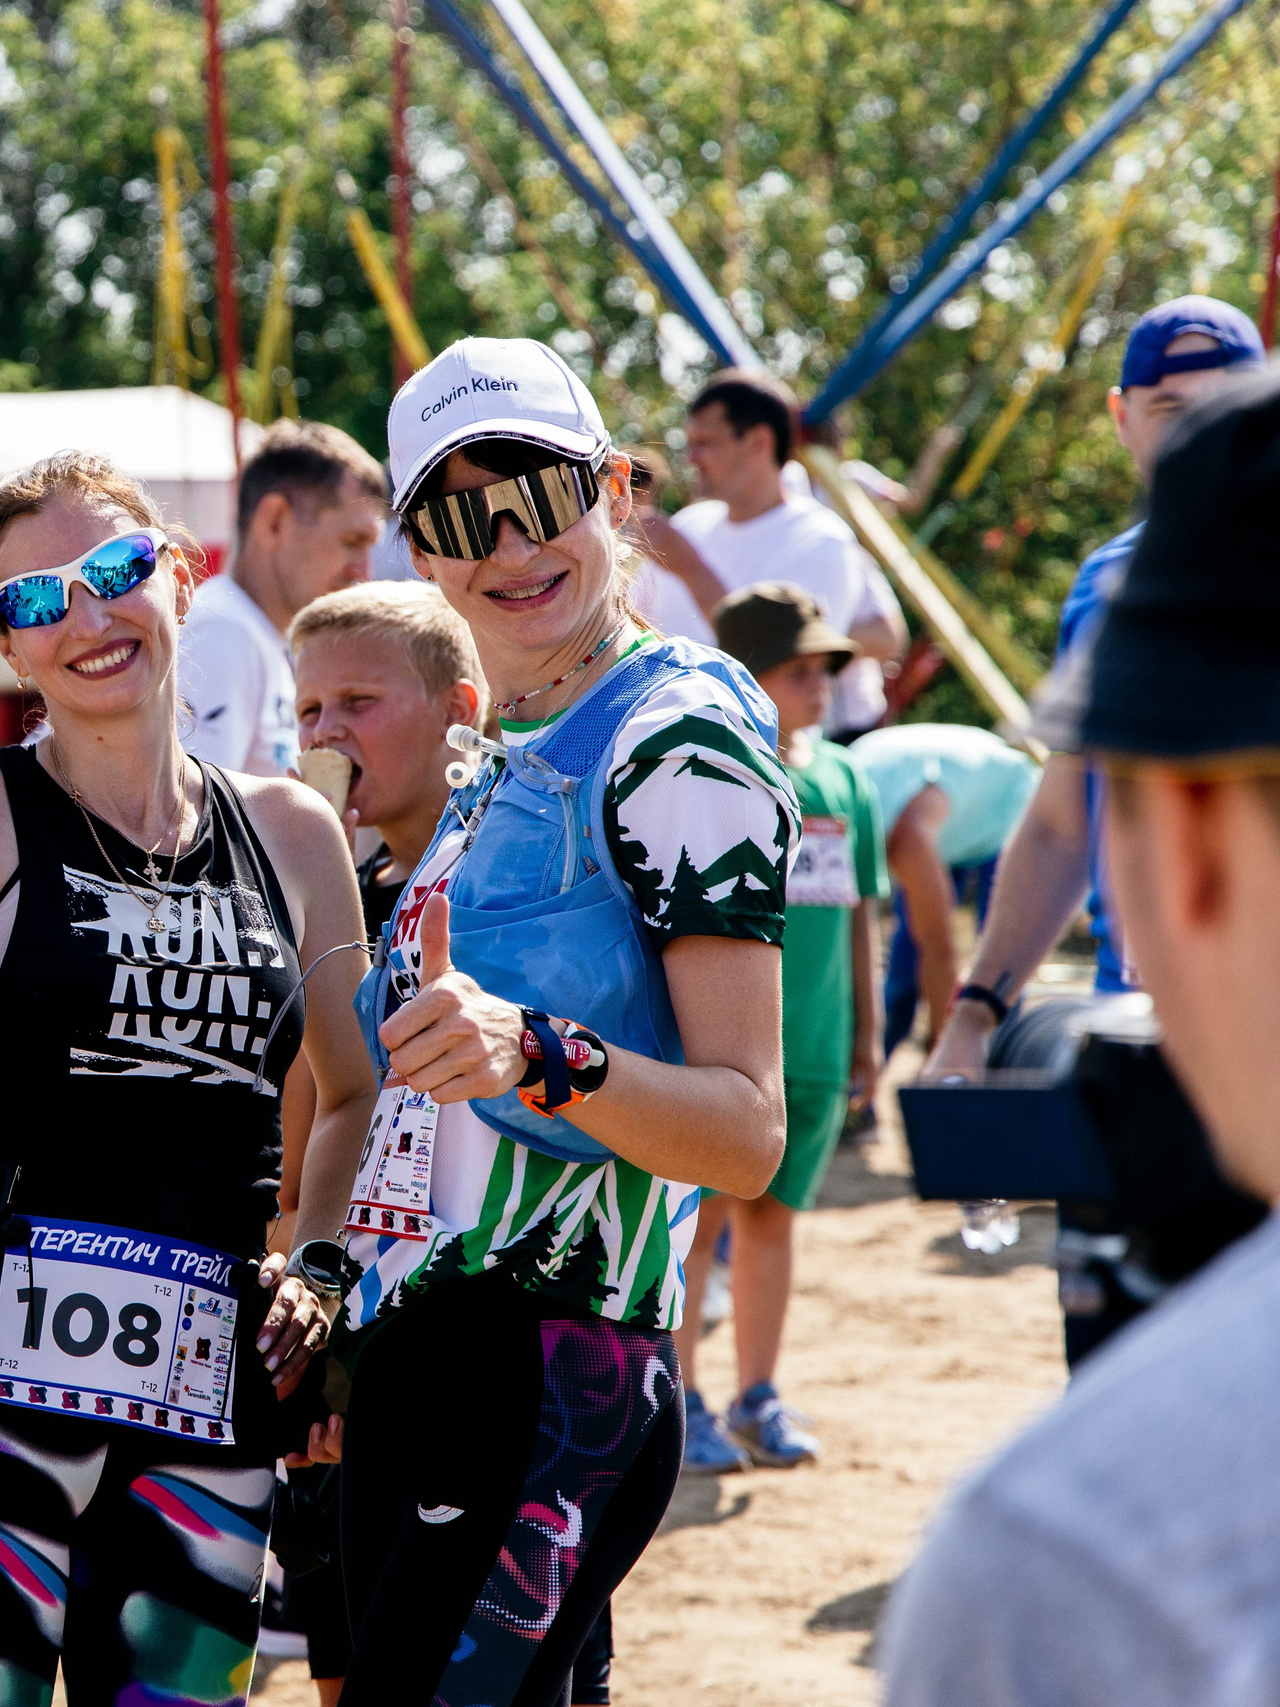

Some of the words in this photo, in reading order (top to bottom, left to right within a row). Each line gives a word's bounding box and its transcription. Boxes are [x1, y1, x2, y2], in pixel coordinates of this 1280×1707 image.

[421, 385, 468, 422] Calvin
[472, 377, 518, 392] Klein
[30, 1225, 161, 1266] ТЕРЕНТИЧ
[170, 1248, 232, 1287] ТРЕЙЛ
[16, 1286, 162, 1367] 108
